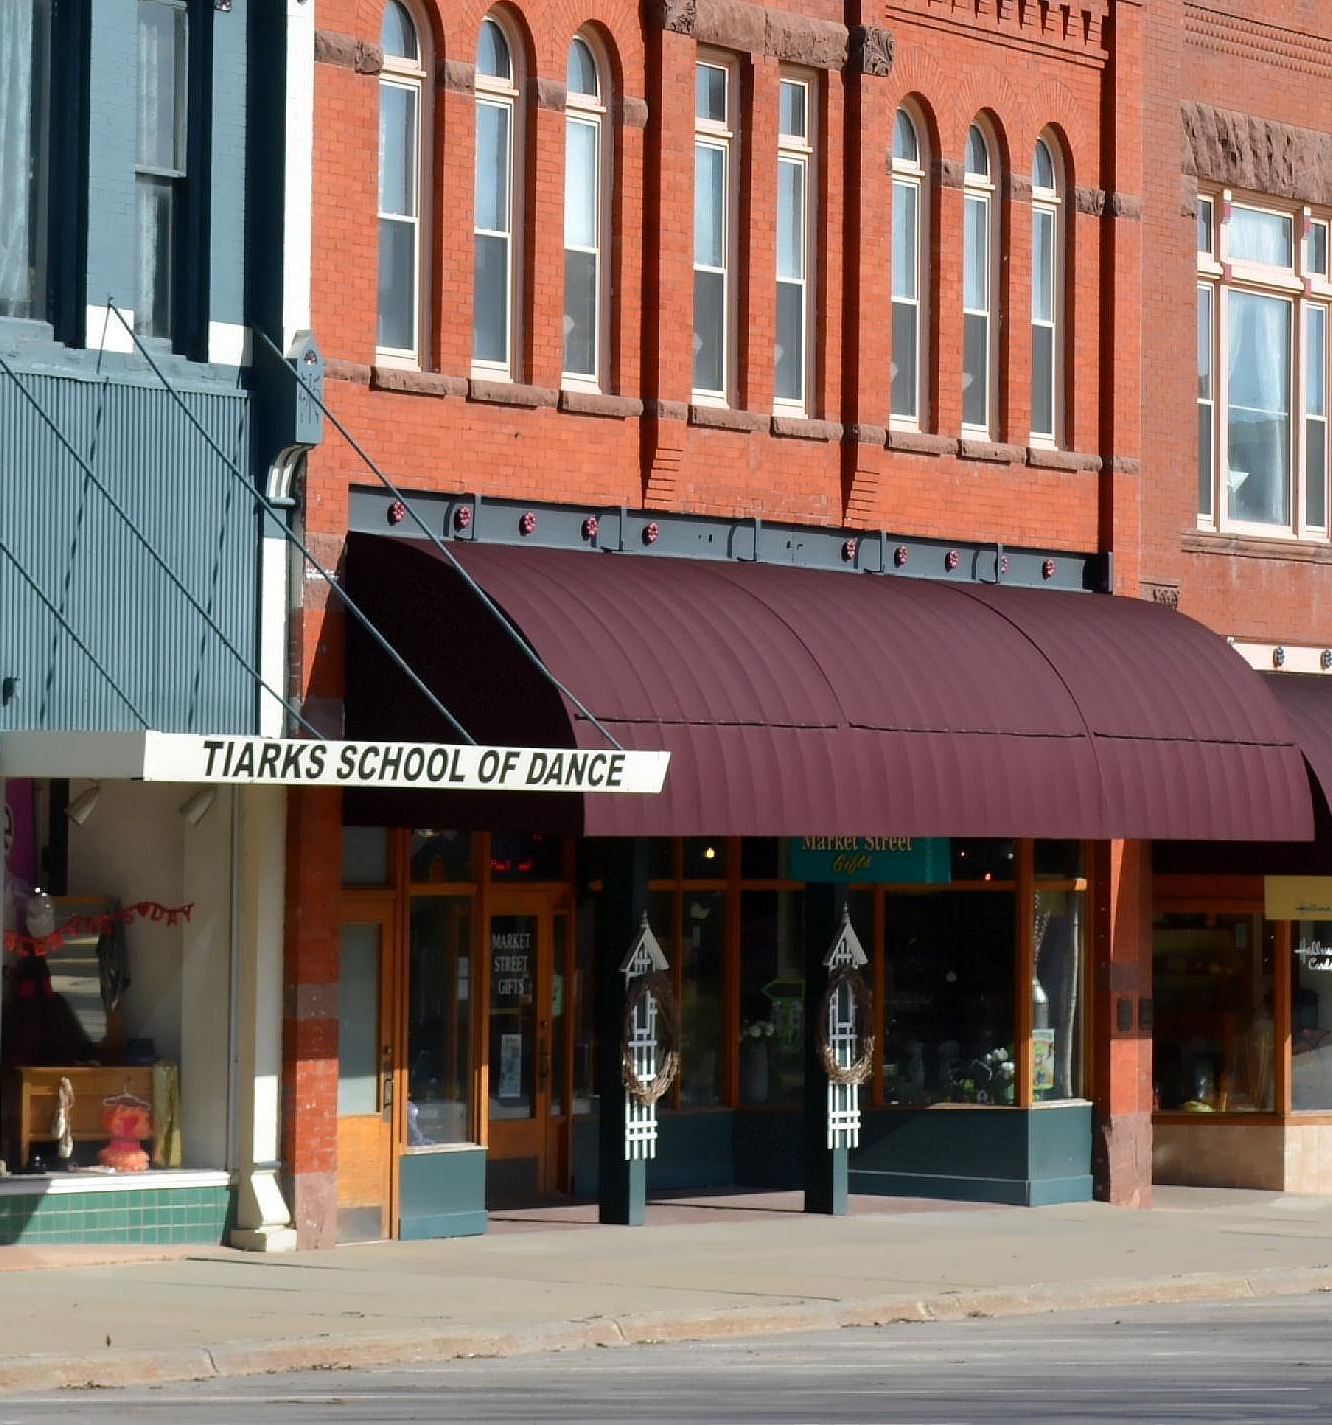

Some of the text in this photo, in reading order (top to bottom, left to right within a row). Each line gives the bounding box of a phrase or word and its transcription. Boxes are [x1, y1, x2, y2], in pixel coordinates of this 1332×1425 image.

[202, 740, 626, 786] TIARKS SCHOOL OF DANCE
[491, 933, 532, 951] MARKET
[494, 955, 528, 973] STREET
